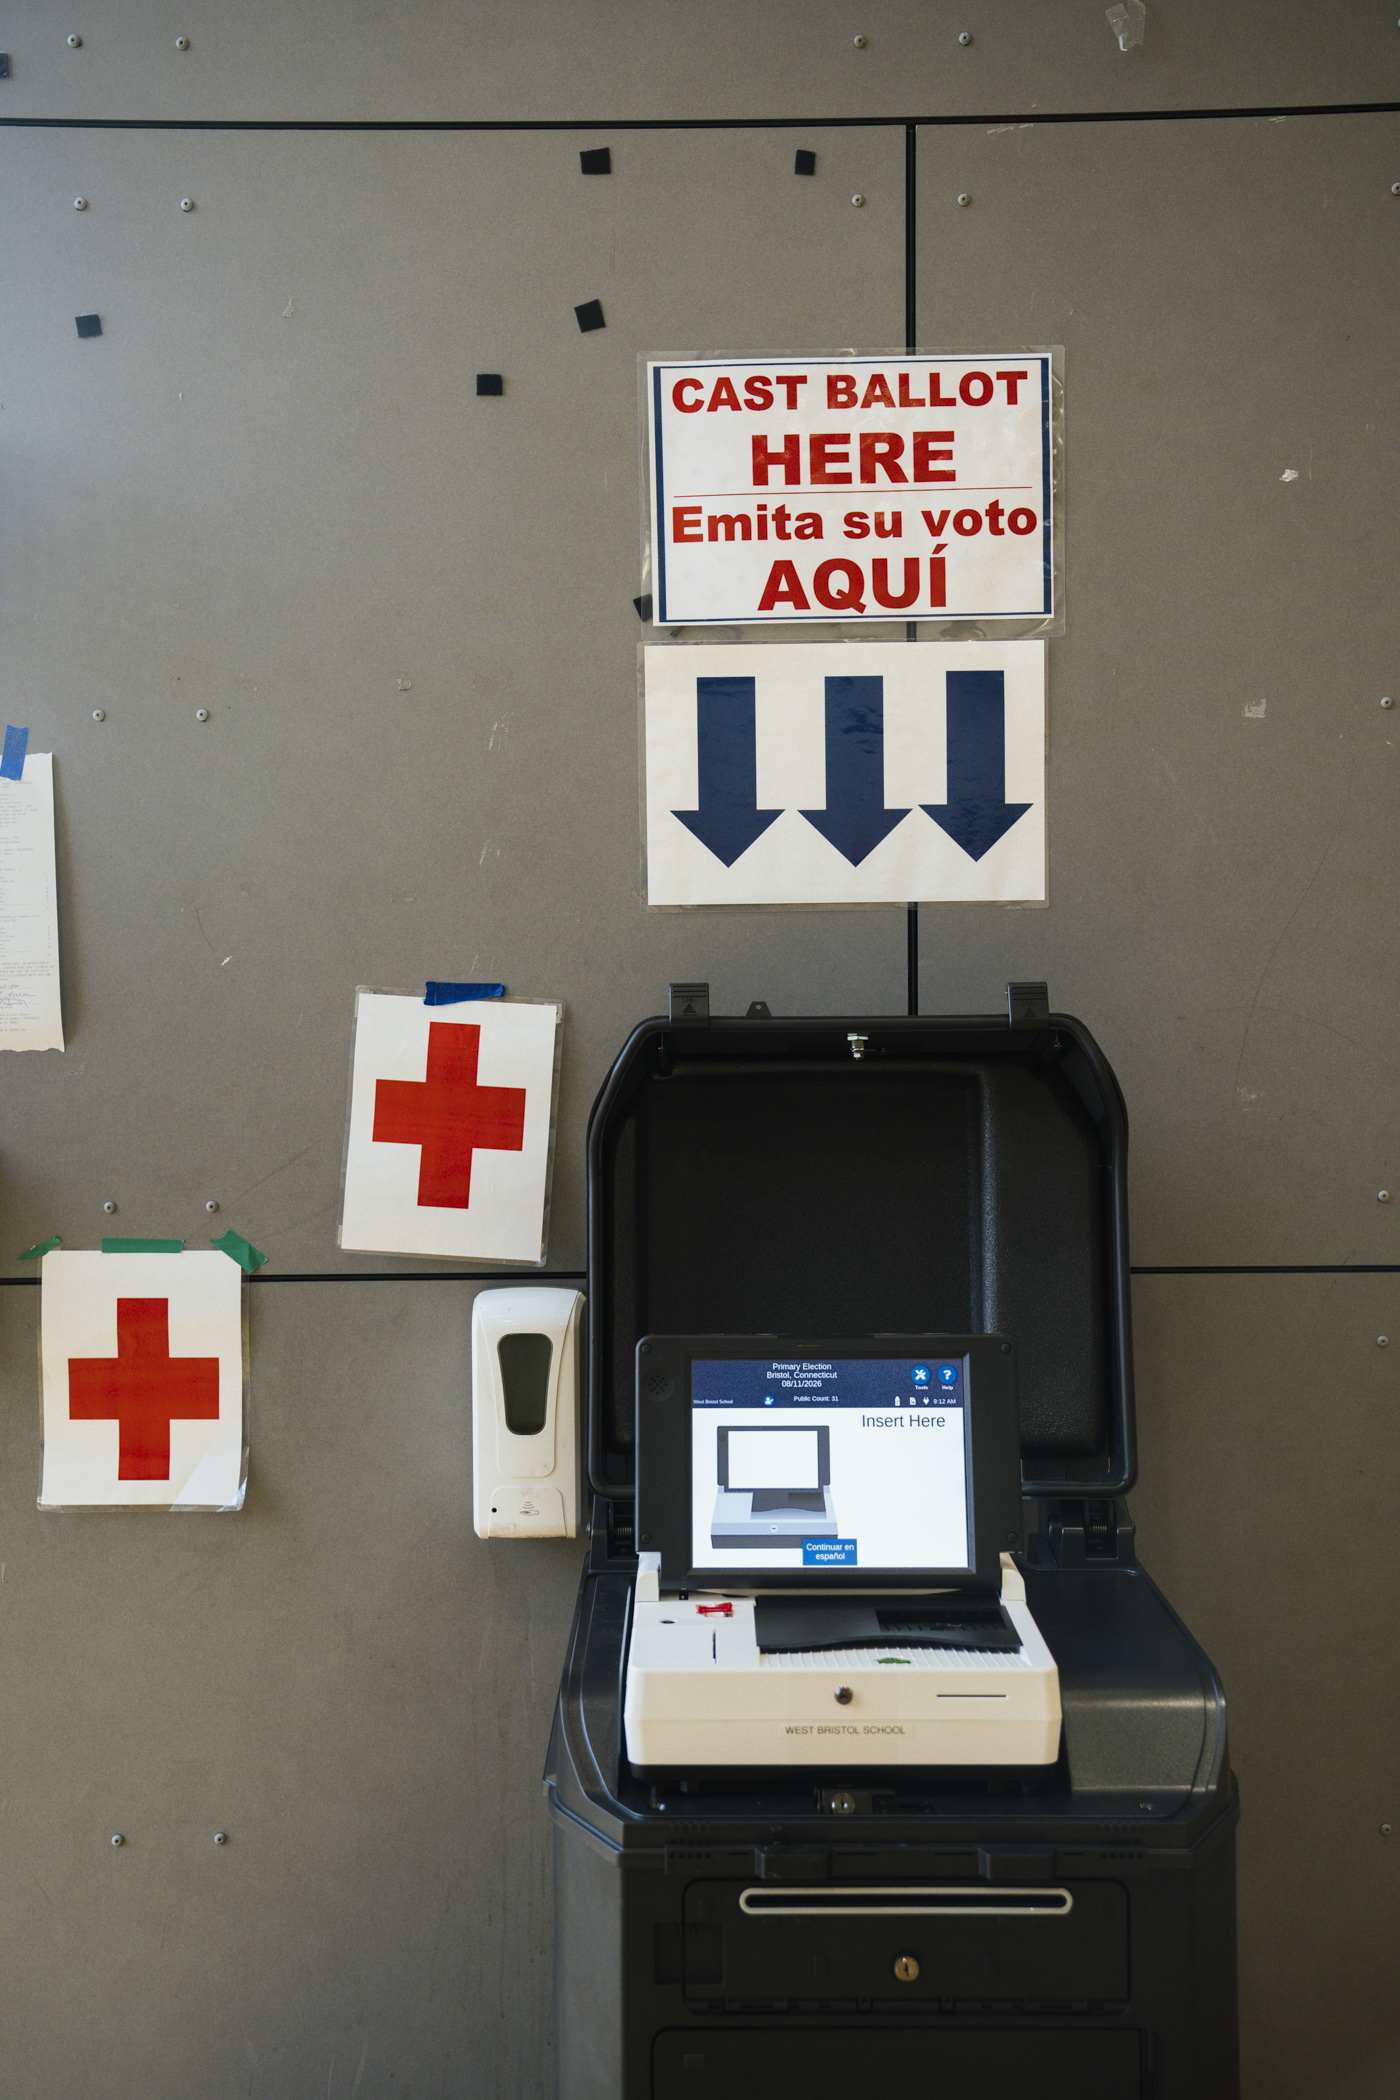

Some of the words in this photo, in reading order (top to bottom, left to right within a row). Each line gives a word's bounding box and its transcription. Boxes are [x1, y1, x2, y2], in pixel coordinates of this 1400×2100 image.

[672, 375, 807, 413] CAST
[827, 371, 1027, 409] BALLOT
[752, 431, 956, 486] HERE
[673, 504, 823, 543] Emita
[843, 511, 902, 539] su
[921, 500, 1037, 536] voto
[758, 544, 948, 614] AQUÍ
[773, 1363, 800, 1371] Primary
[767, 1371, 791, 1379] Bristol,
[794, 1371, 837, 1379] Connecticut
[782, 1380, 822, 1388] 08/11/2026
[862, 1414, 904, 1427] Insert
[909, 1414, 946, 1427] Here
[815, 1552, 846, 1561] español
[785, 1726, 814, 1734] WEST
[817, 1726, 860, 1734] BRISTOL
[863, 1726, 906, 1734] SCHOOL
